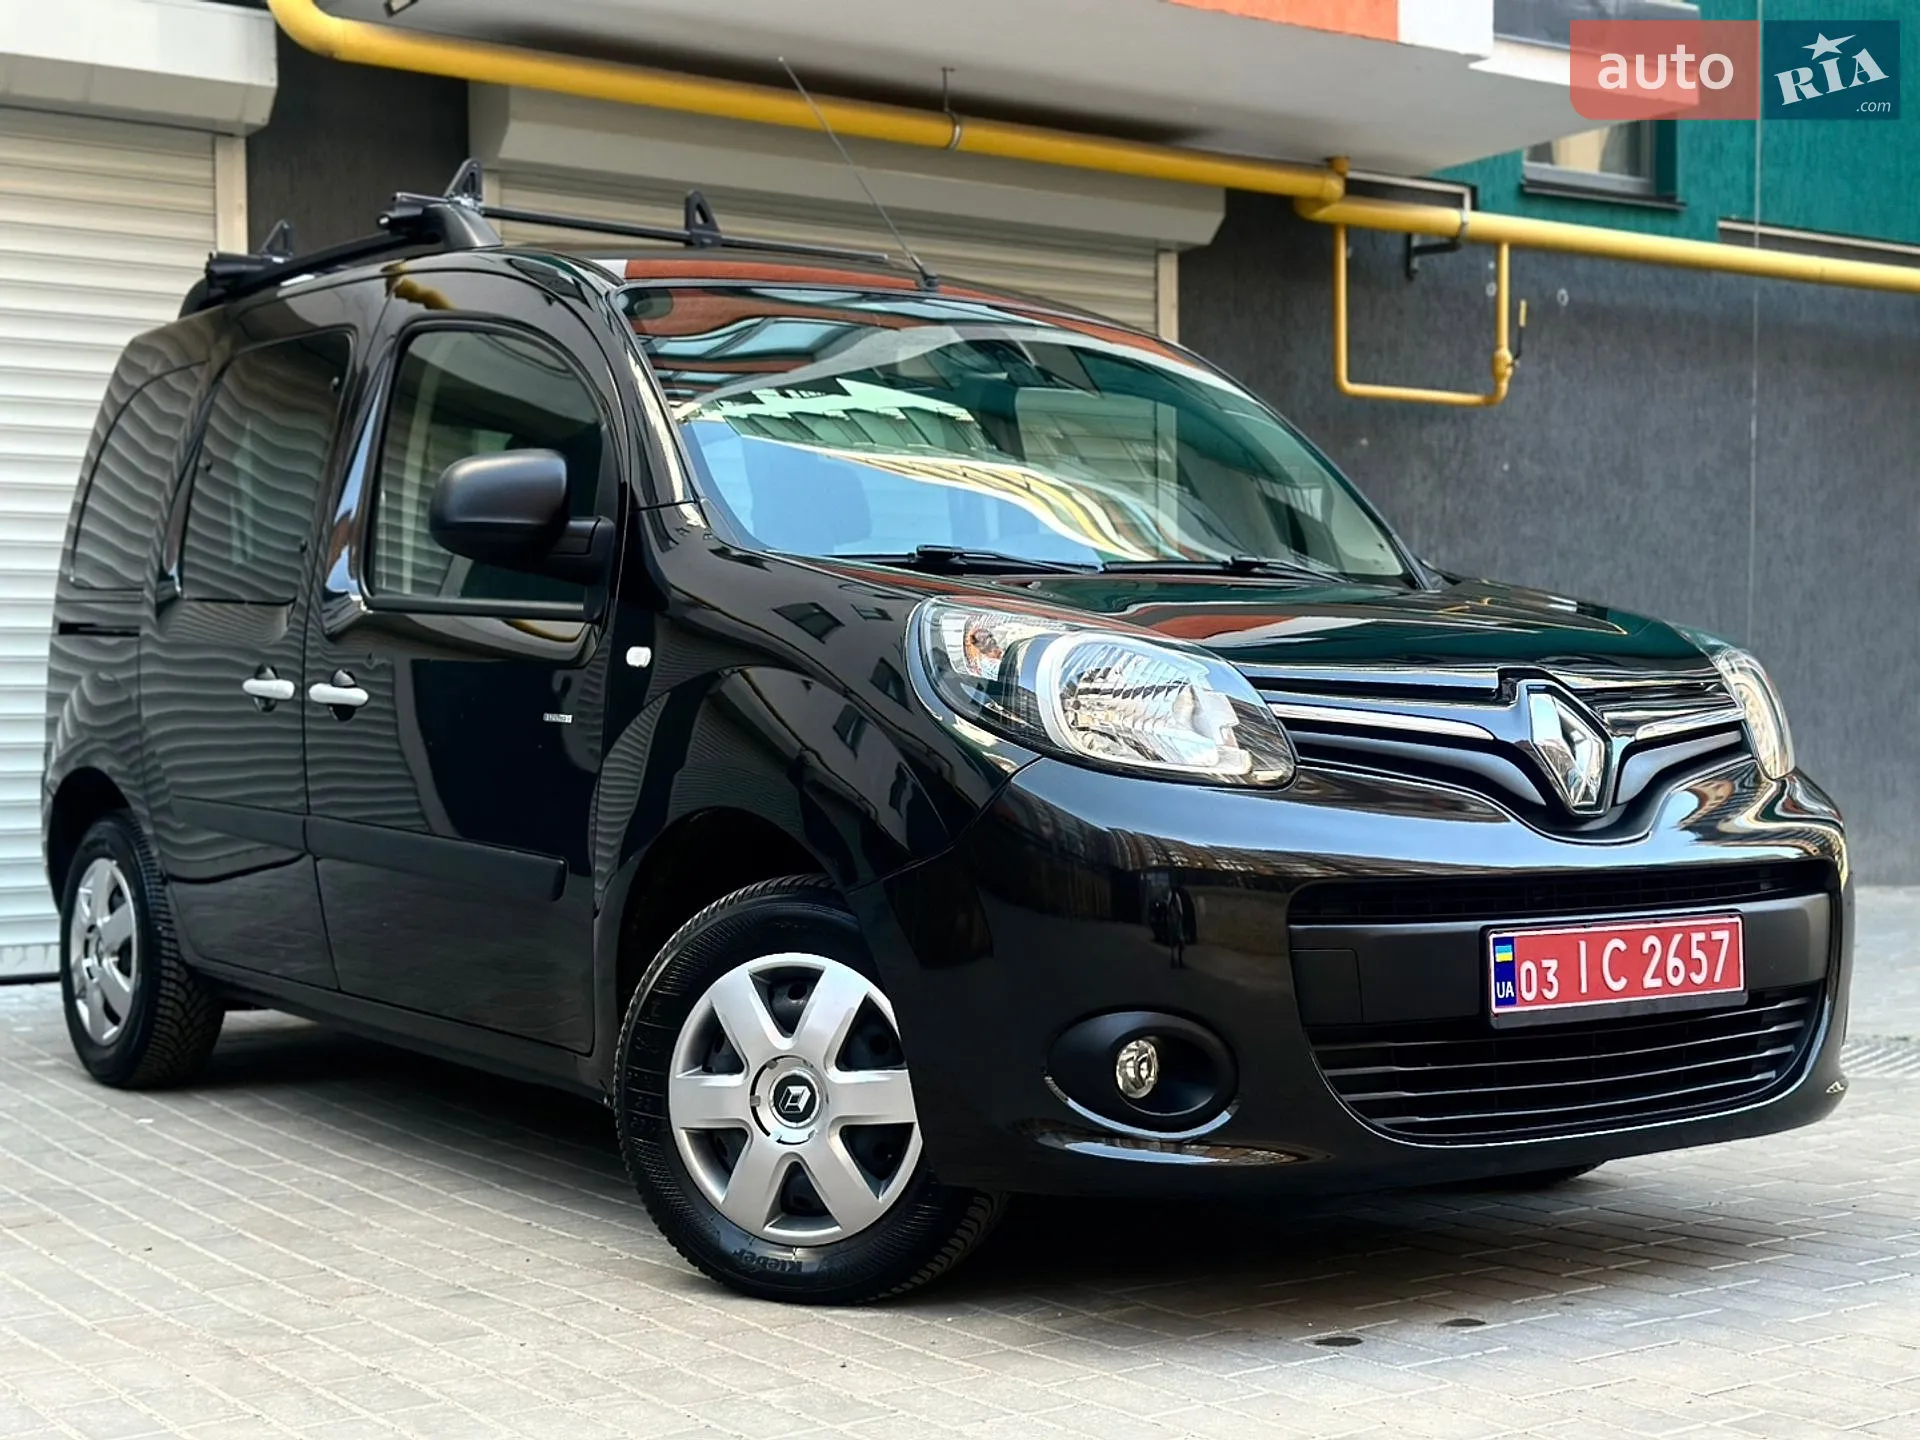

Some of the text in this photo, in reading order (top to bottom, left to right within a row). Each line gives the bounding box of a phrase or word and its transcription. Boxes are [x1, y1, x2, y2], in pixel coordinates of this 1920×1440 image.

[1520, 930, 1730, 1002] 03 IC 2657
[1496, 981, 1515, 998] UA
